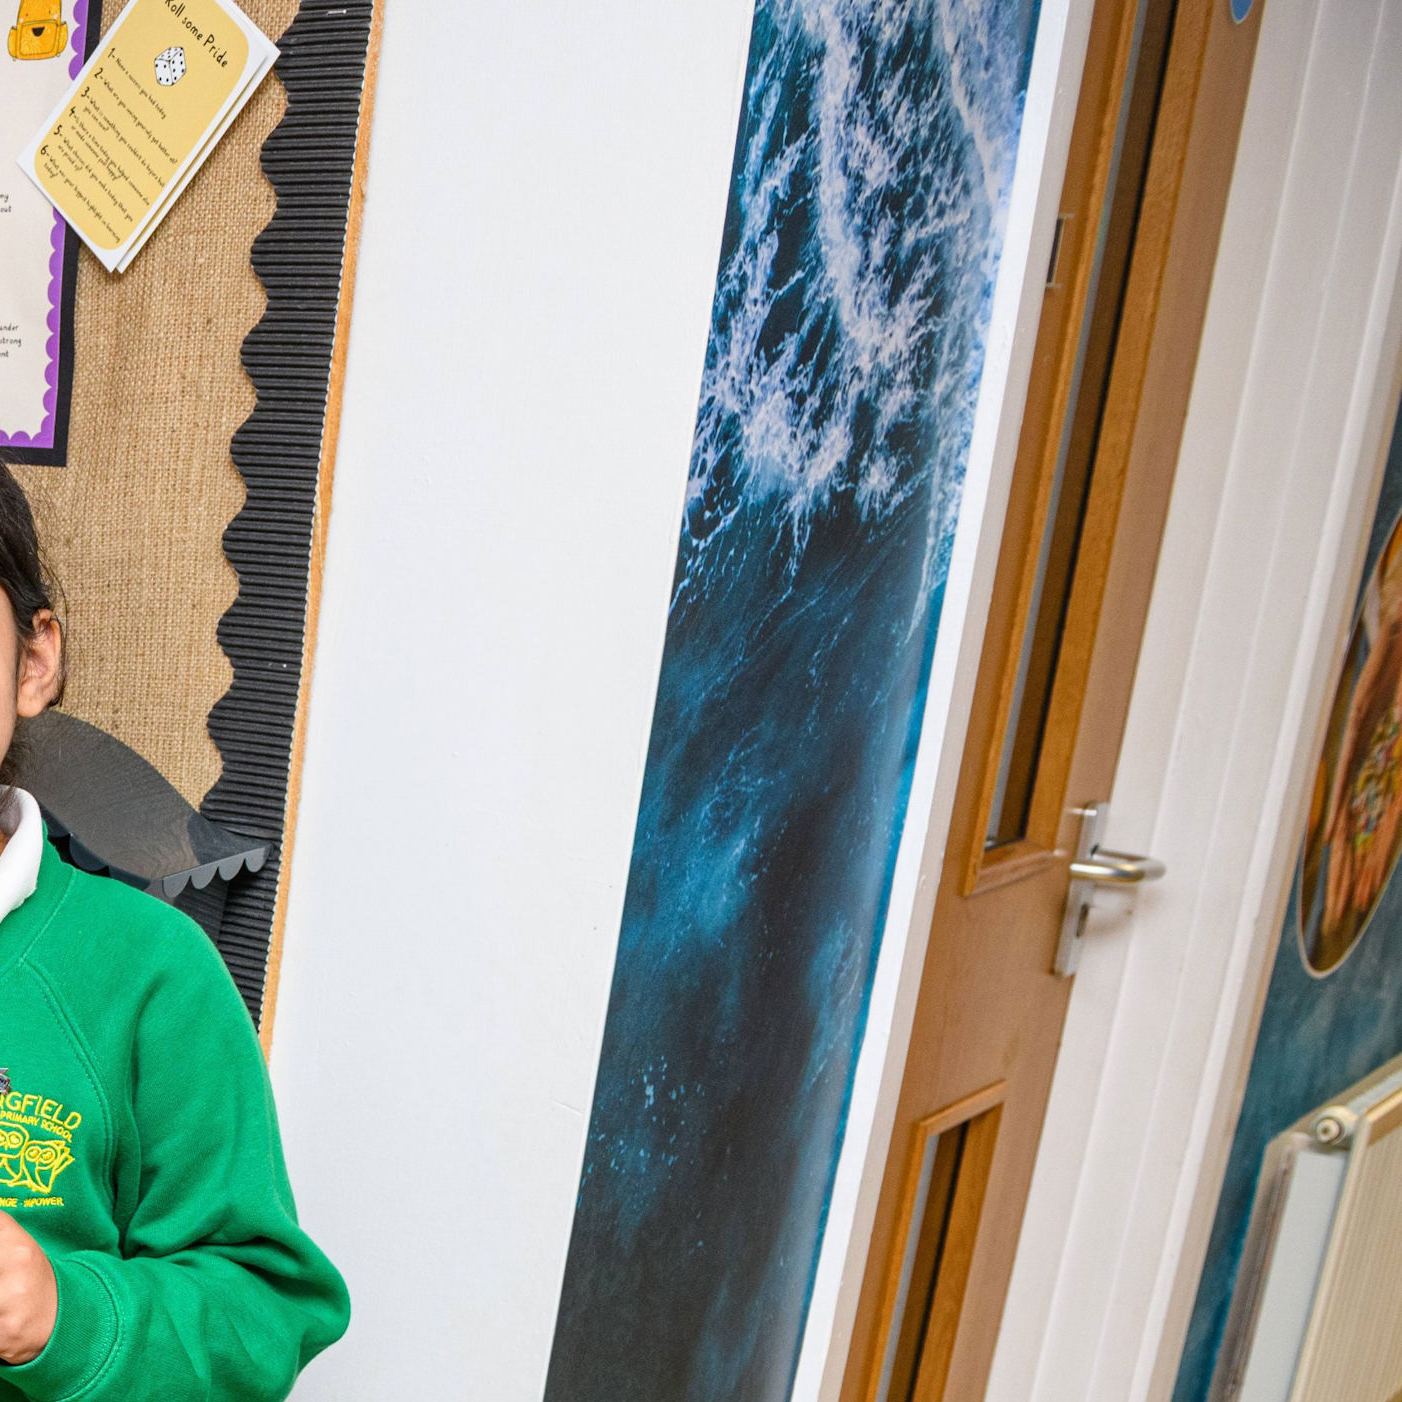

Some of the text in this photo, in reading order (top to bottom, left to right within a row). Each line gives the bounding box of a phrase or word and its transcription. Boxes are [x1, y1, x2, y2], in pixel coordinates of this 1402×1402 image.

[181, 16, 203, 41] some
[203, 34, 228, 68] Pride
[0, 194, 9, 202] my
[0, 337, 21, 347] strong
[0, 1110, 39, 1126] PRIMARY
[41, 1119, 72, 1143] SCHOOL
